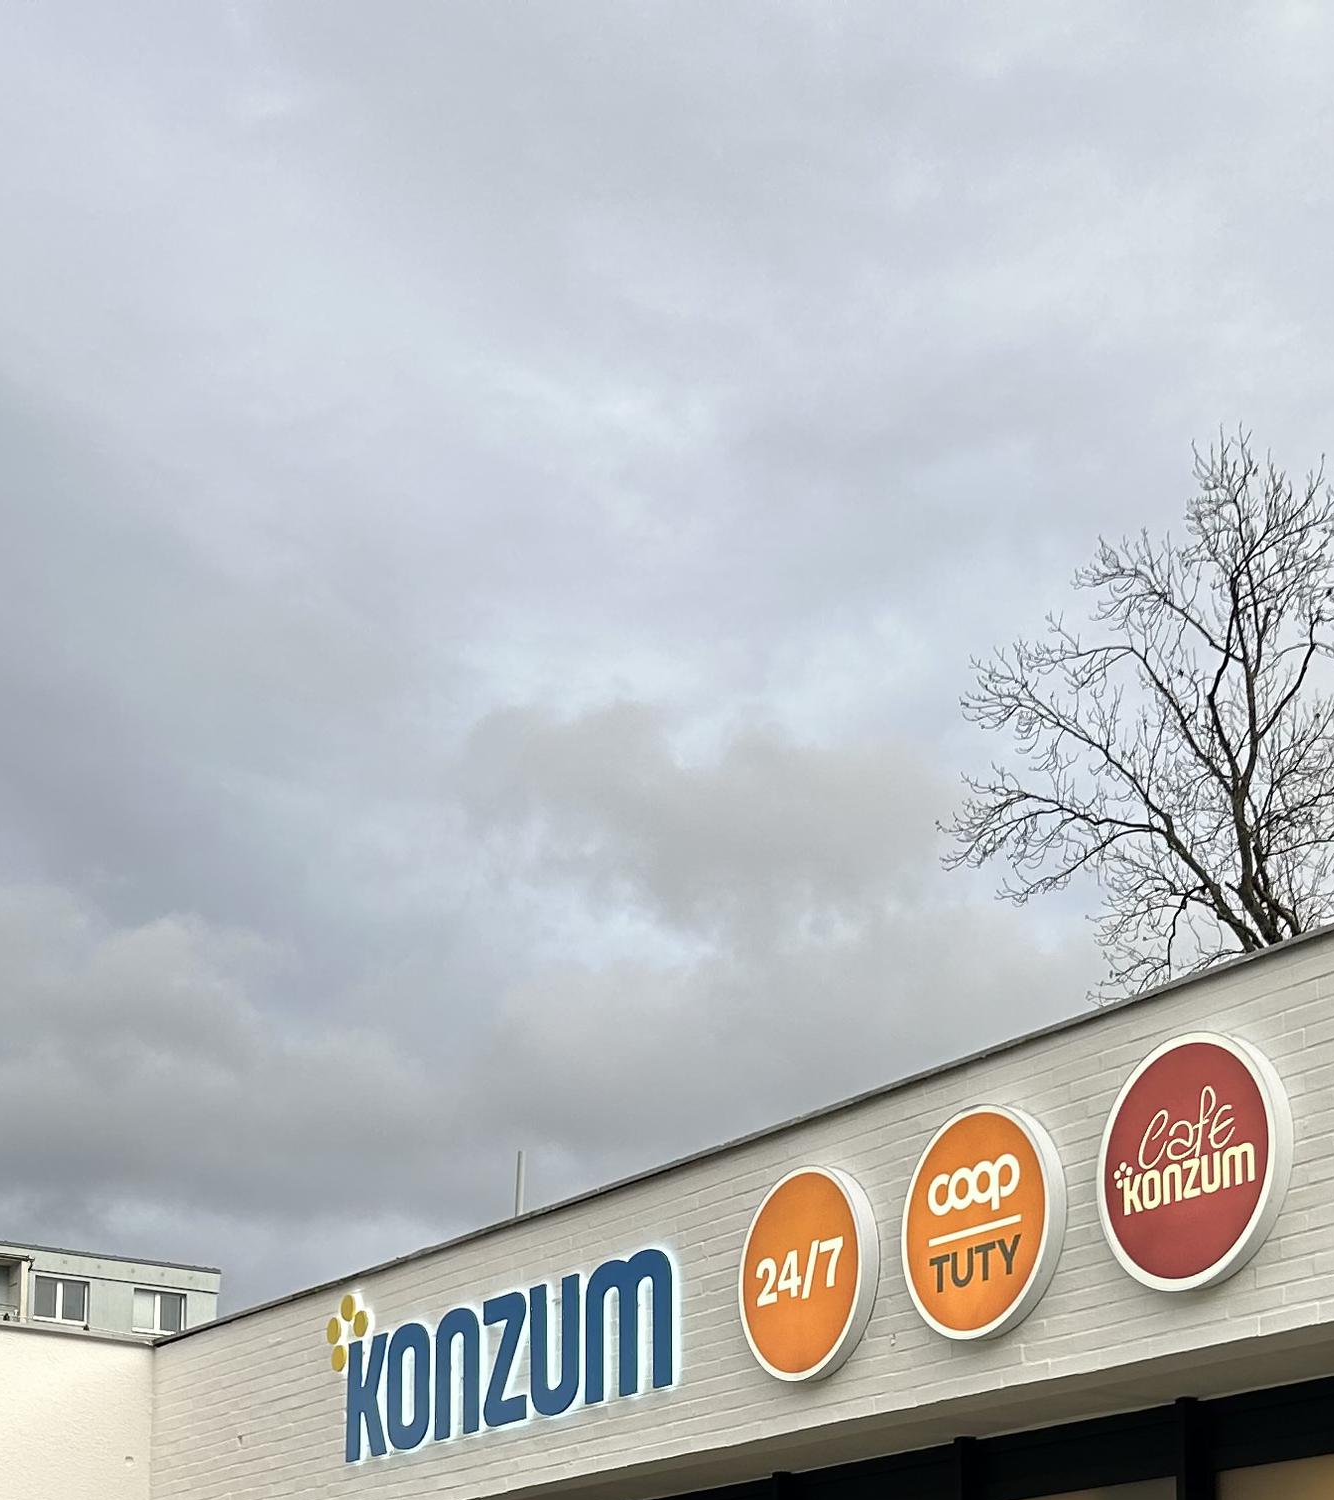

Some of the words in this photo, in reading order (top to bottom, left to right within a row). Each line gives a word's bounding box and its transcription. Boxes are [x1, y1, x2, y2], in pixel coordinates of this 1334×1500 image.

[928, 1153, 1020, 1216] coop
[755, 1236, 844, 1308] 24/7
[929, 1234, 1021, 1293] TUTY
